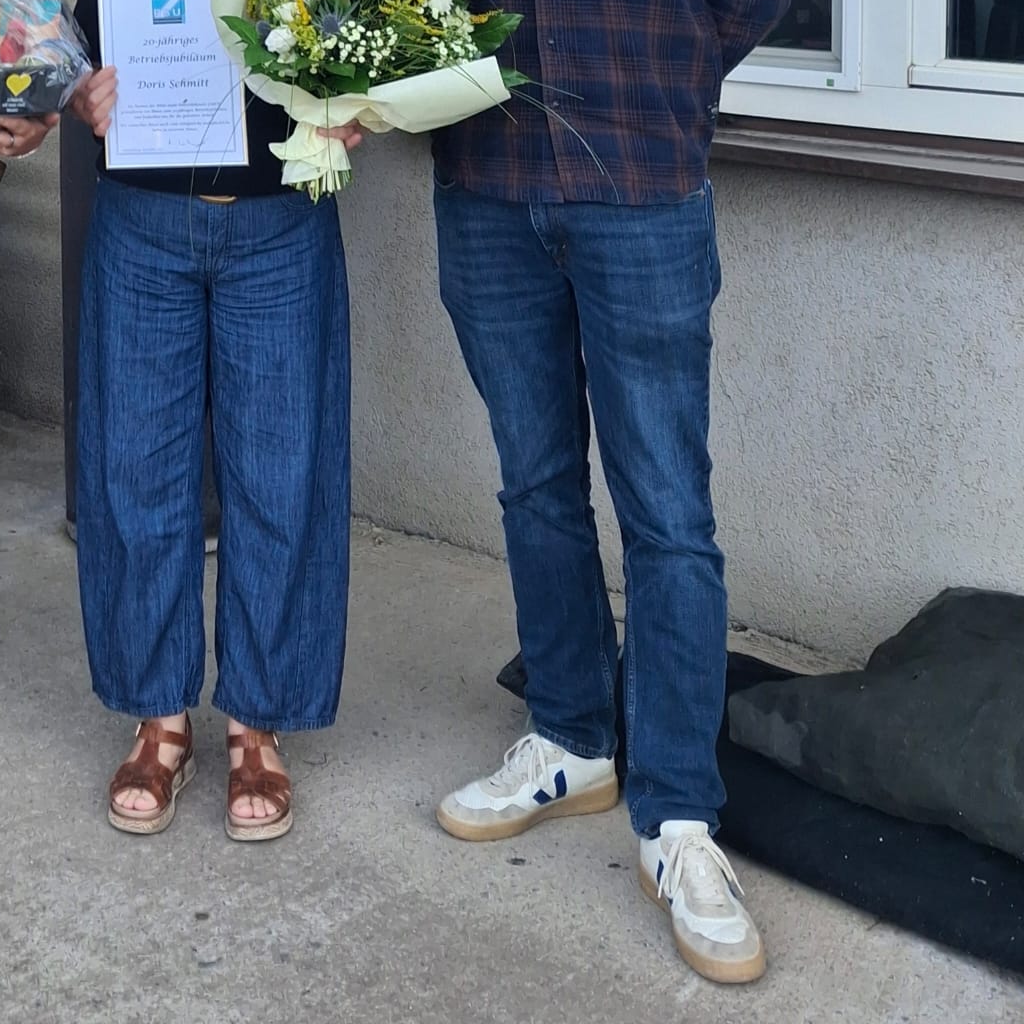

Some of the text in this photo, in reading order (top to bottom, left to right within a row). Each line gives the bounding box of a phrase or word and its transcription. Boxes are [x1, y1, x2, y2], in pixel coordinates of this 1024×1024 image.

[143, 35, 198, 49] 20-jähriges
[128, 51, 216, 67] Betriebsjubiläum
[137, 77, 208, 89] Doris Schmitt
